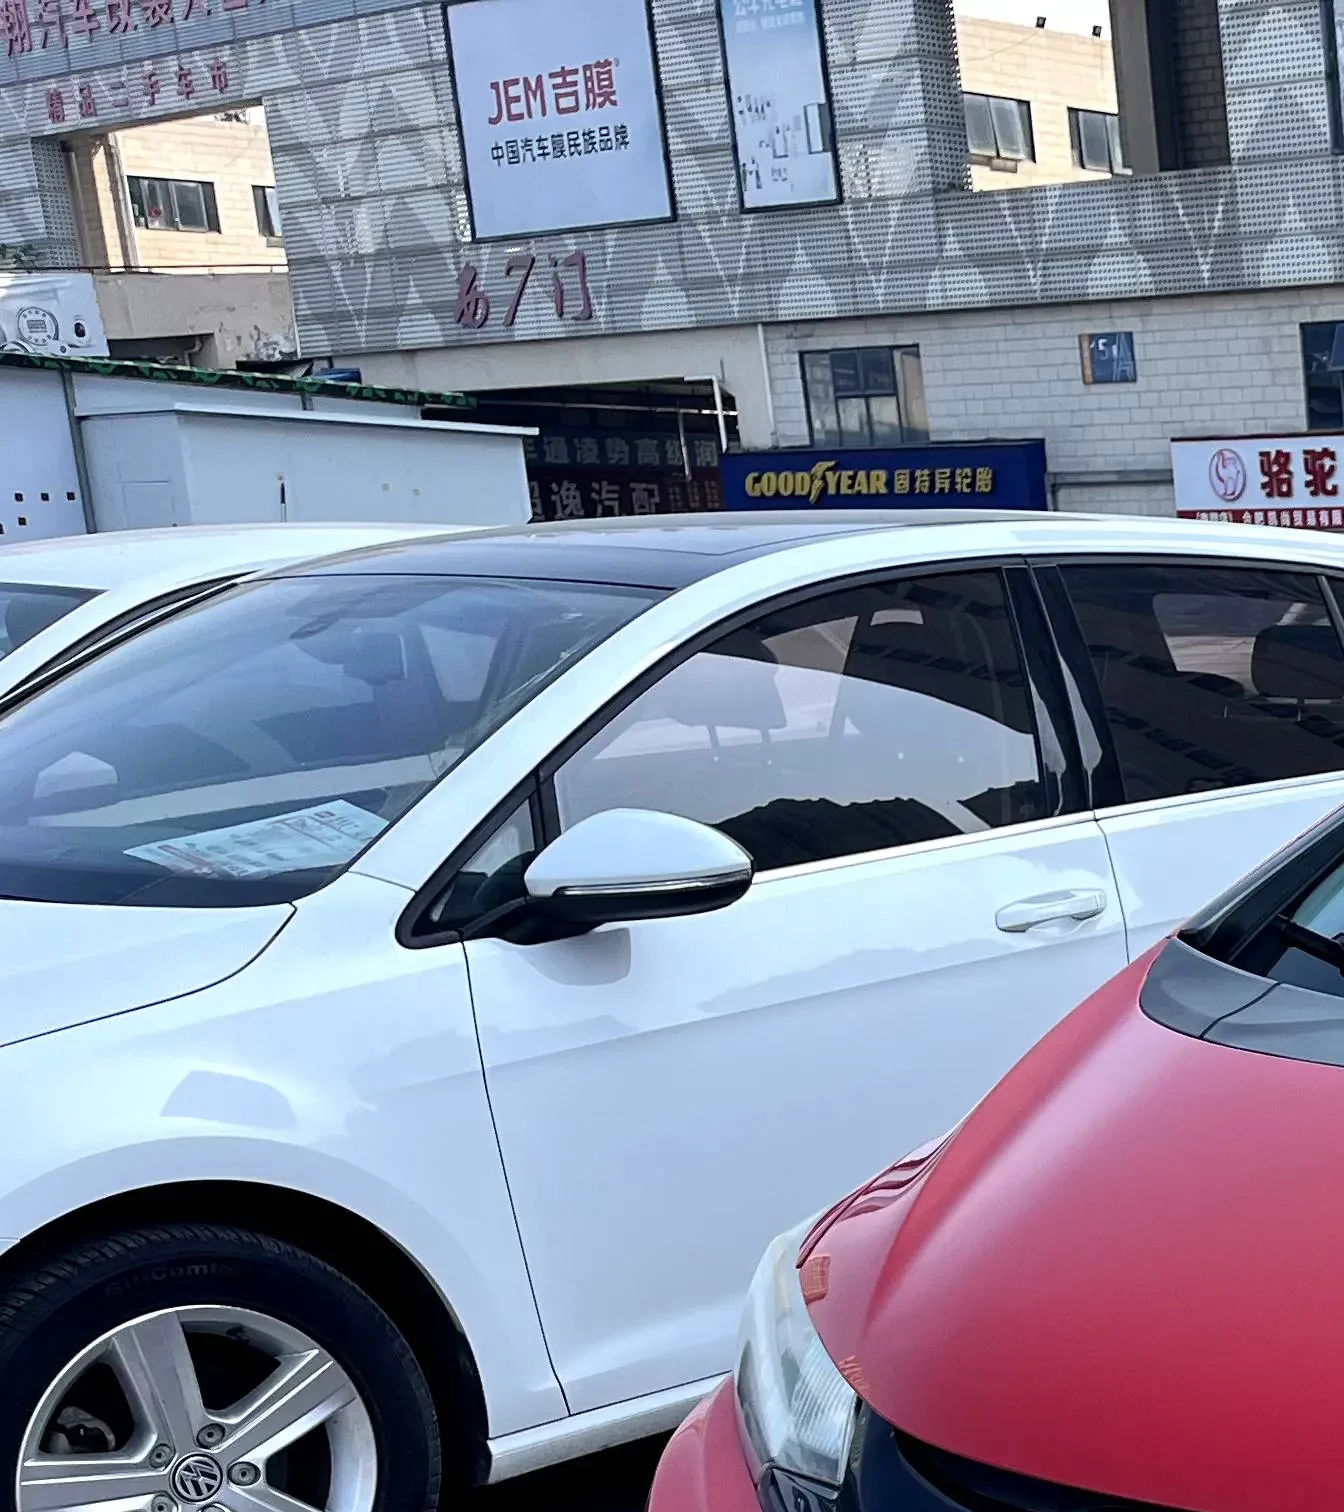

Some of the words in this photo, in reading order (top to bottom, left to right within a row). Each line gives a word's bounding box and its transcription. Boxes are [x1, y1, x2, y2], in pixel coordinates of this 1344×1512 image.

[745, 465, 888, 500] GOODYEAR
[893, 467, 994, 494] 固特异轮胎
